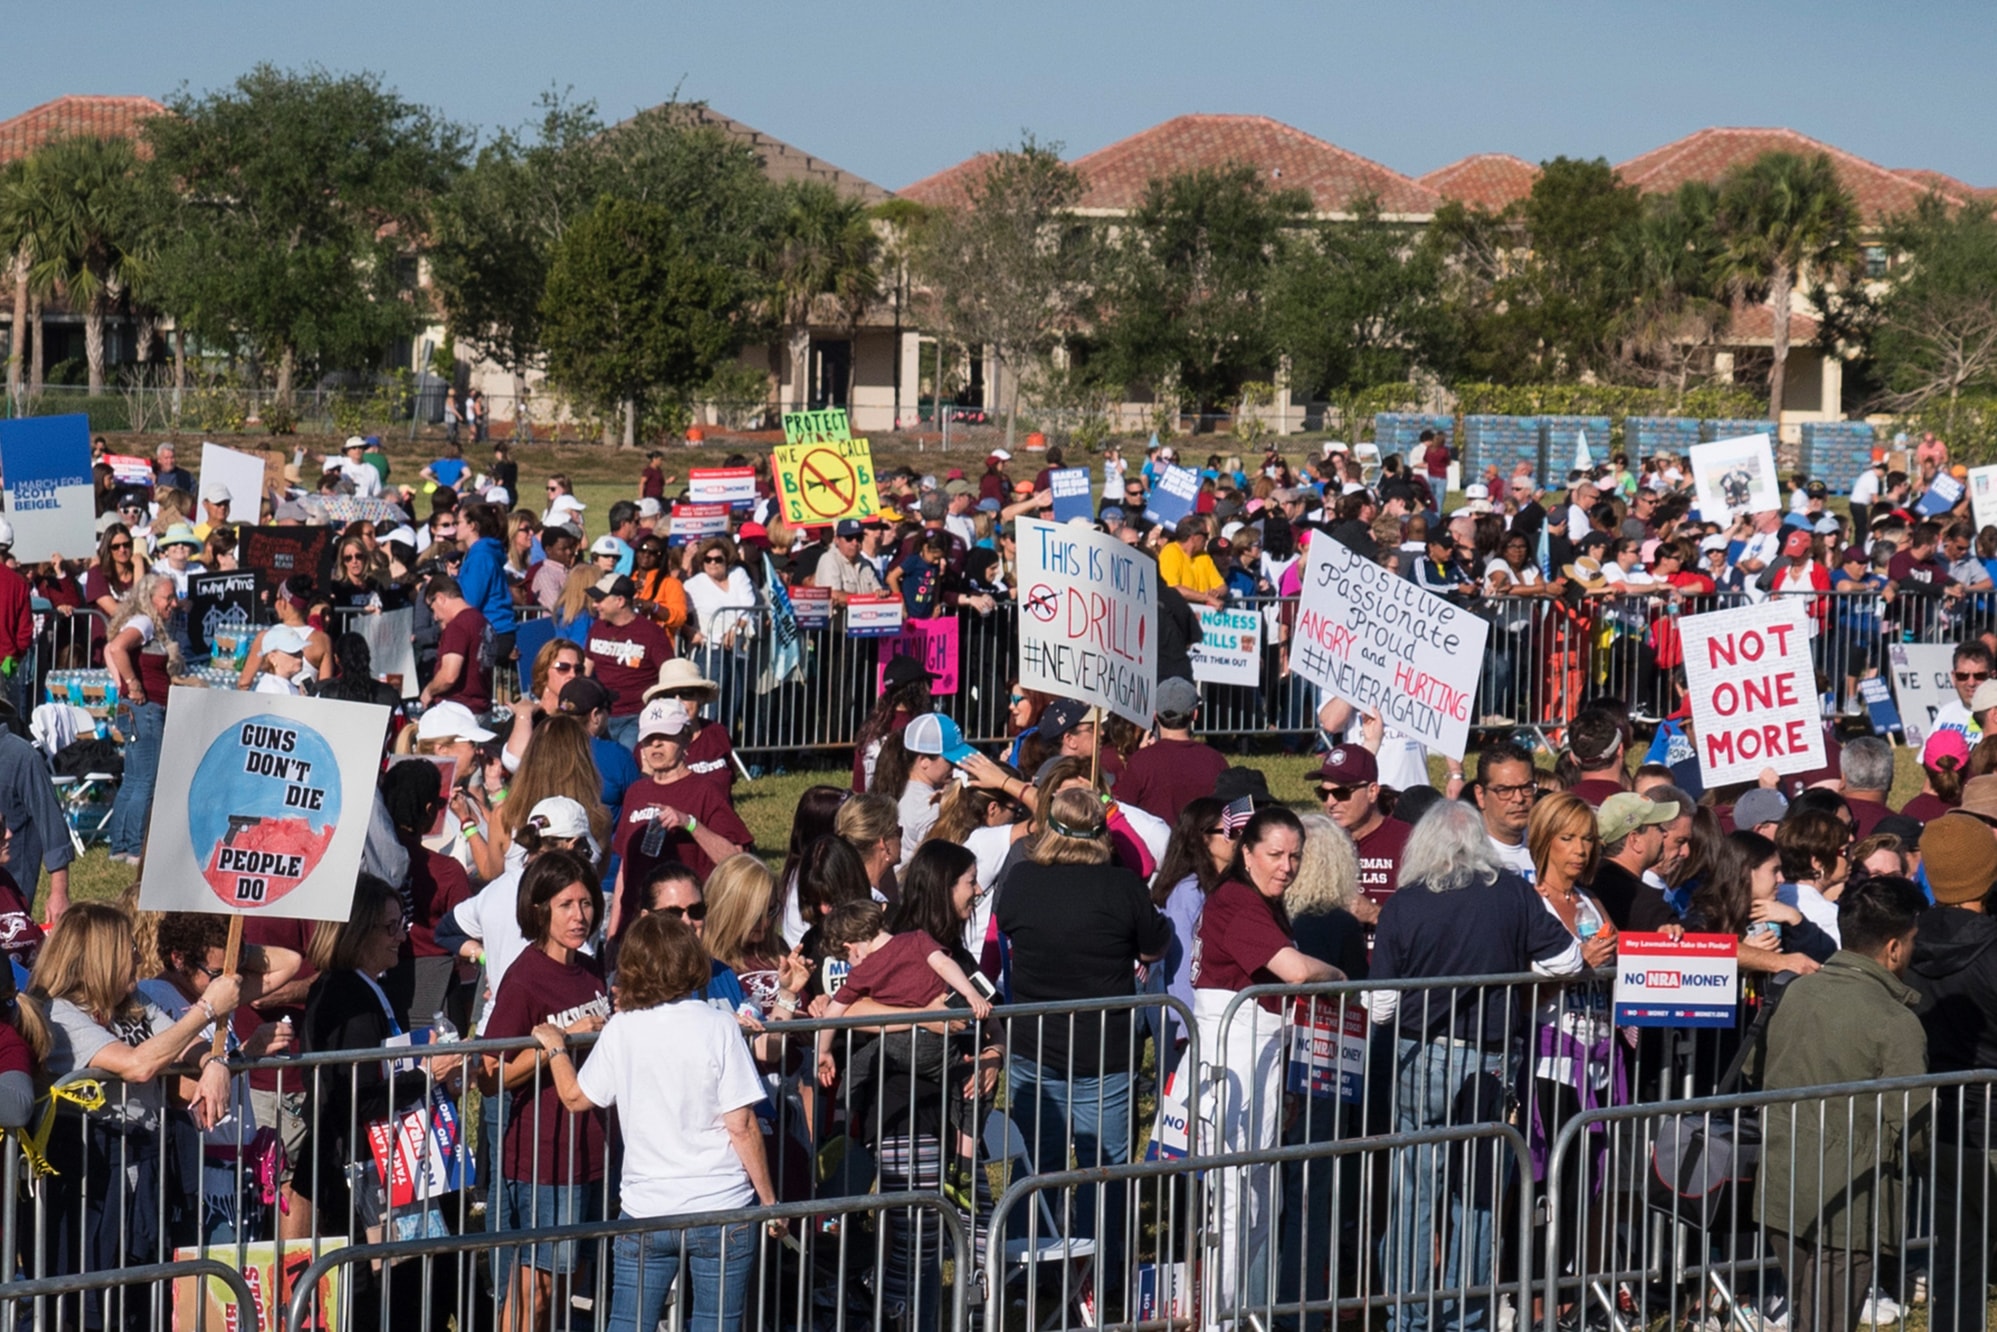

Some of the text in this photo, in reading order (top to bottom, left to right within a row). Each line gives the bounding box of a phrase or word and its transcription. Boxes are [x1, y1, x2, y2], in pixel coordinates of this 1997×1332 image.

[785, 412, 847, 434] PROTECT
[777, 438, 870, 463] WE CALL
[14, 488, 55, 500] SCOTT
[19, 479, 58, 490] MARCH
[60, 476, 84, 487] FOR
[15, 499, 61, 512] BEIGEL
[1033, 526, 1147, 604] THIS IS NOT A
[224, 577, 255, 592] Arms
[1067, 586, 1146, 665] DRILL!
[1346, 607, 1417, 664] Proud
[1707, 623, 1794, 669] NOT
[1210, 656, 1230, 665] THEM
[1232, 658, 1247, 667] OUT
[1299, 608, 1470, 722] ANGRY and HURTING
[1024, 636, 1151, 716] #NEVERAGAIN
[1301, 645, 1444, 740] #NEVERAGAIN
[1712, 671, 1799, 716] ONE
[241, 724, 297, 752] GUNS
[1706, 719, 1809, 769] MORE
[246, 751, 311, 782] DON'T
[285, 784, 324, 811] DIE
[218, 848, 302, 877] PEOPLE
[237, 877, 264, 901] DO
[1625, 972, 1730, 987] NO NRA MONEY
